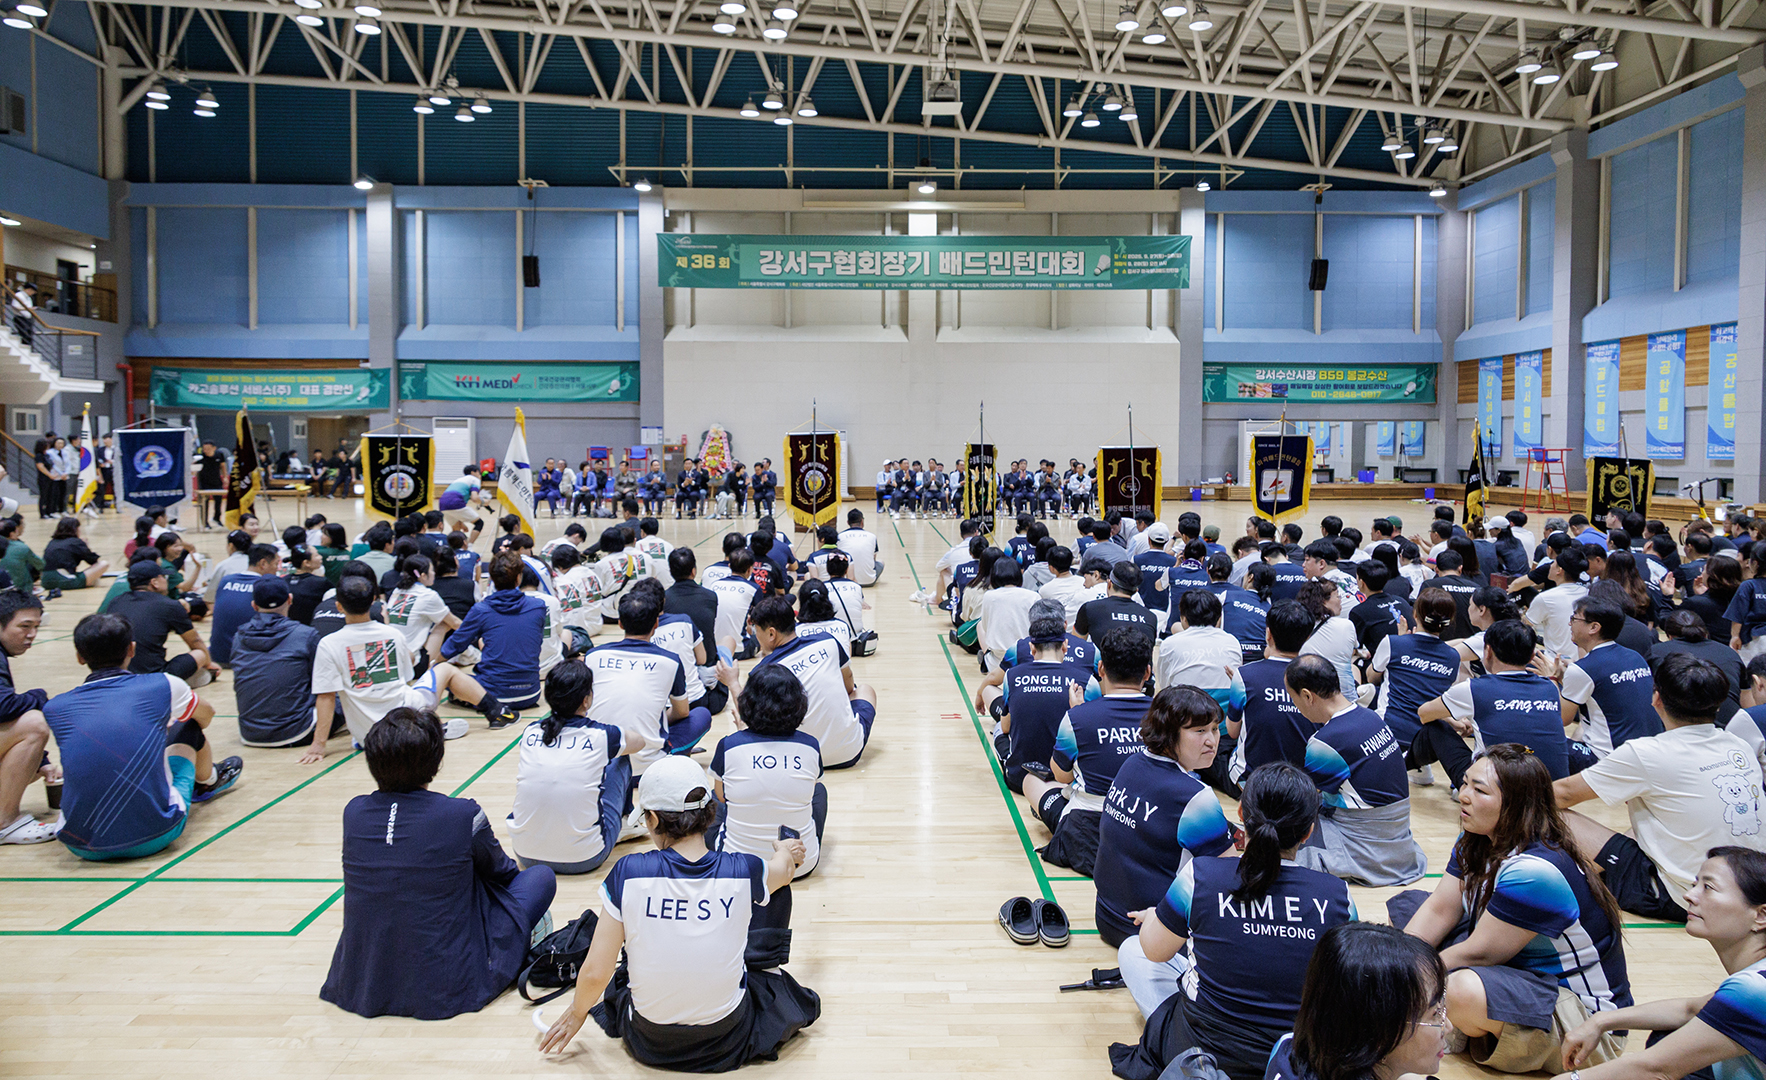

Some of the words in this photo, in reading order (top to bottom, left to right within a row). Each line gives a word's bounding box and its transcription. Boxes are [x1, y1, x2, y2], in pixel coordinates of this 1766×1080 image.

[676, 256, 688, 268] 제
[691, 254, 715, 269] 36
[718, 256, 730, 269] 회
[758, 249, 931, 277] 강서구협회장기
[938, 250, 1085, 277] 배드민턴대회
[453, 375, 480, 388] KH
[1255, 369, 1316, 381] 강서수산시장
[299, 384, 320, 395] 대표
[1311, 390, 1327, 398] 010
[1111, 612, 1130, 622] LEE
[1131, 613, 1138, 622] S
[1139, 615, 1146, 624] K
[669, 632, 675, 641] Y
[680, 630, 685, 639] J
[809, 654, 819, 664] C
[820, 649, 829, 659] H
[1074, 646, 1085, 658] G
[599, 657, 623, 670] LEE
[628, 660, 637, 671] Y
[643, 661, 657, 672] W
[1400, 654, 1431, 674] BANG
[1429, 661, 1454, 676] HWA
[1014, 675, 1049, 687] SONG
[1052, 675, 1061, 685] H
[1065, 677, 1075, 686] M
[1609, 668, 1637, 685] BANG
[1494, 699, 1533, 714] BANG
[1531, 699, 1558, 712] HWA
[1097, 727, 1144, 744] PARK
[1359, 728, 1390, 756] HWANG
[570, 737, 578, 751] J
[581, 738, 594, 752] A
[752, 755, 778, 770] KO
[793, 755, 802, 770] S
[1104, 803, 1137, 829] SUMYEONG
[1128, 796, 1140, 815] J
[1143, 801, 1158, 822] Y
[646, 897, 688, 921] LEE
[697, 899, 711, 921] S
[719, 897, 735, 919] Y
[1218, 892, 1274, 921] KIM
[1286, 896, 1303, 921] E
[1314, 898, 1329, 924] Y
[1242, 922, 1316, 940] SUMYEONG
